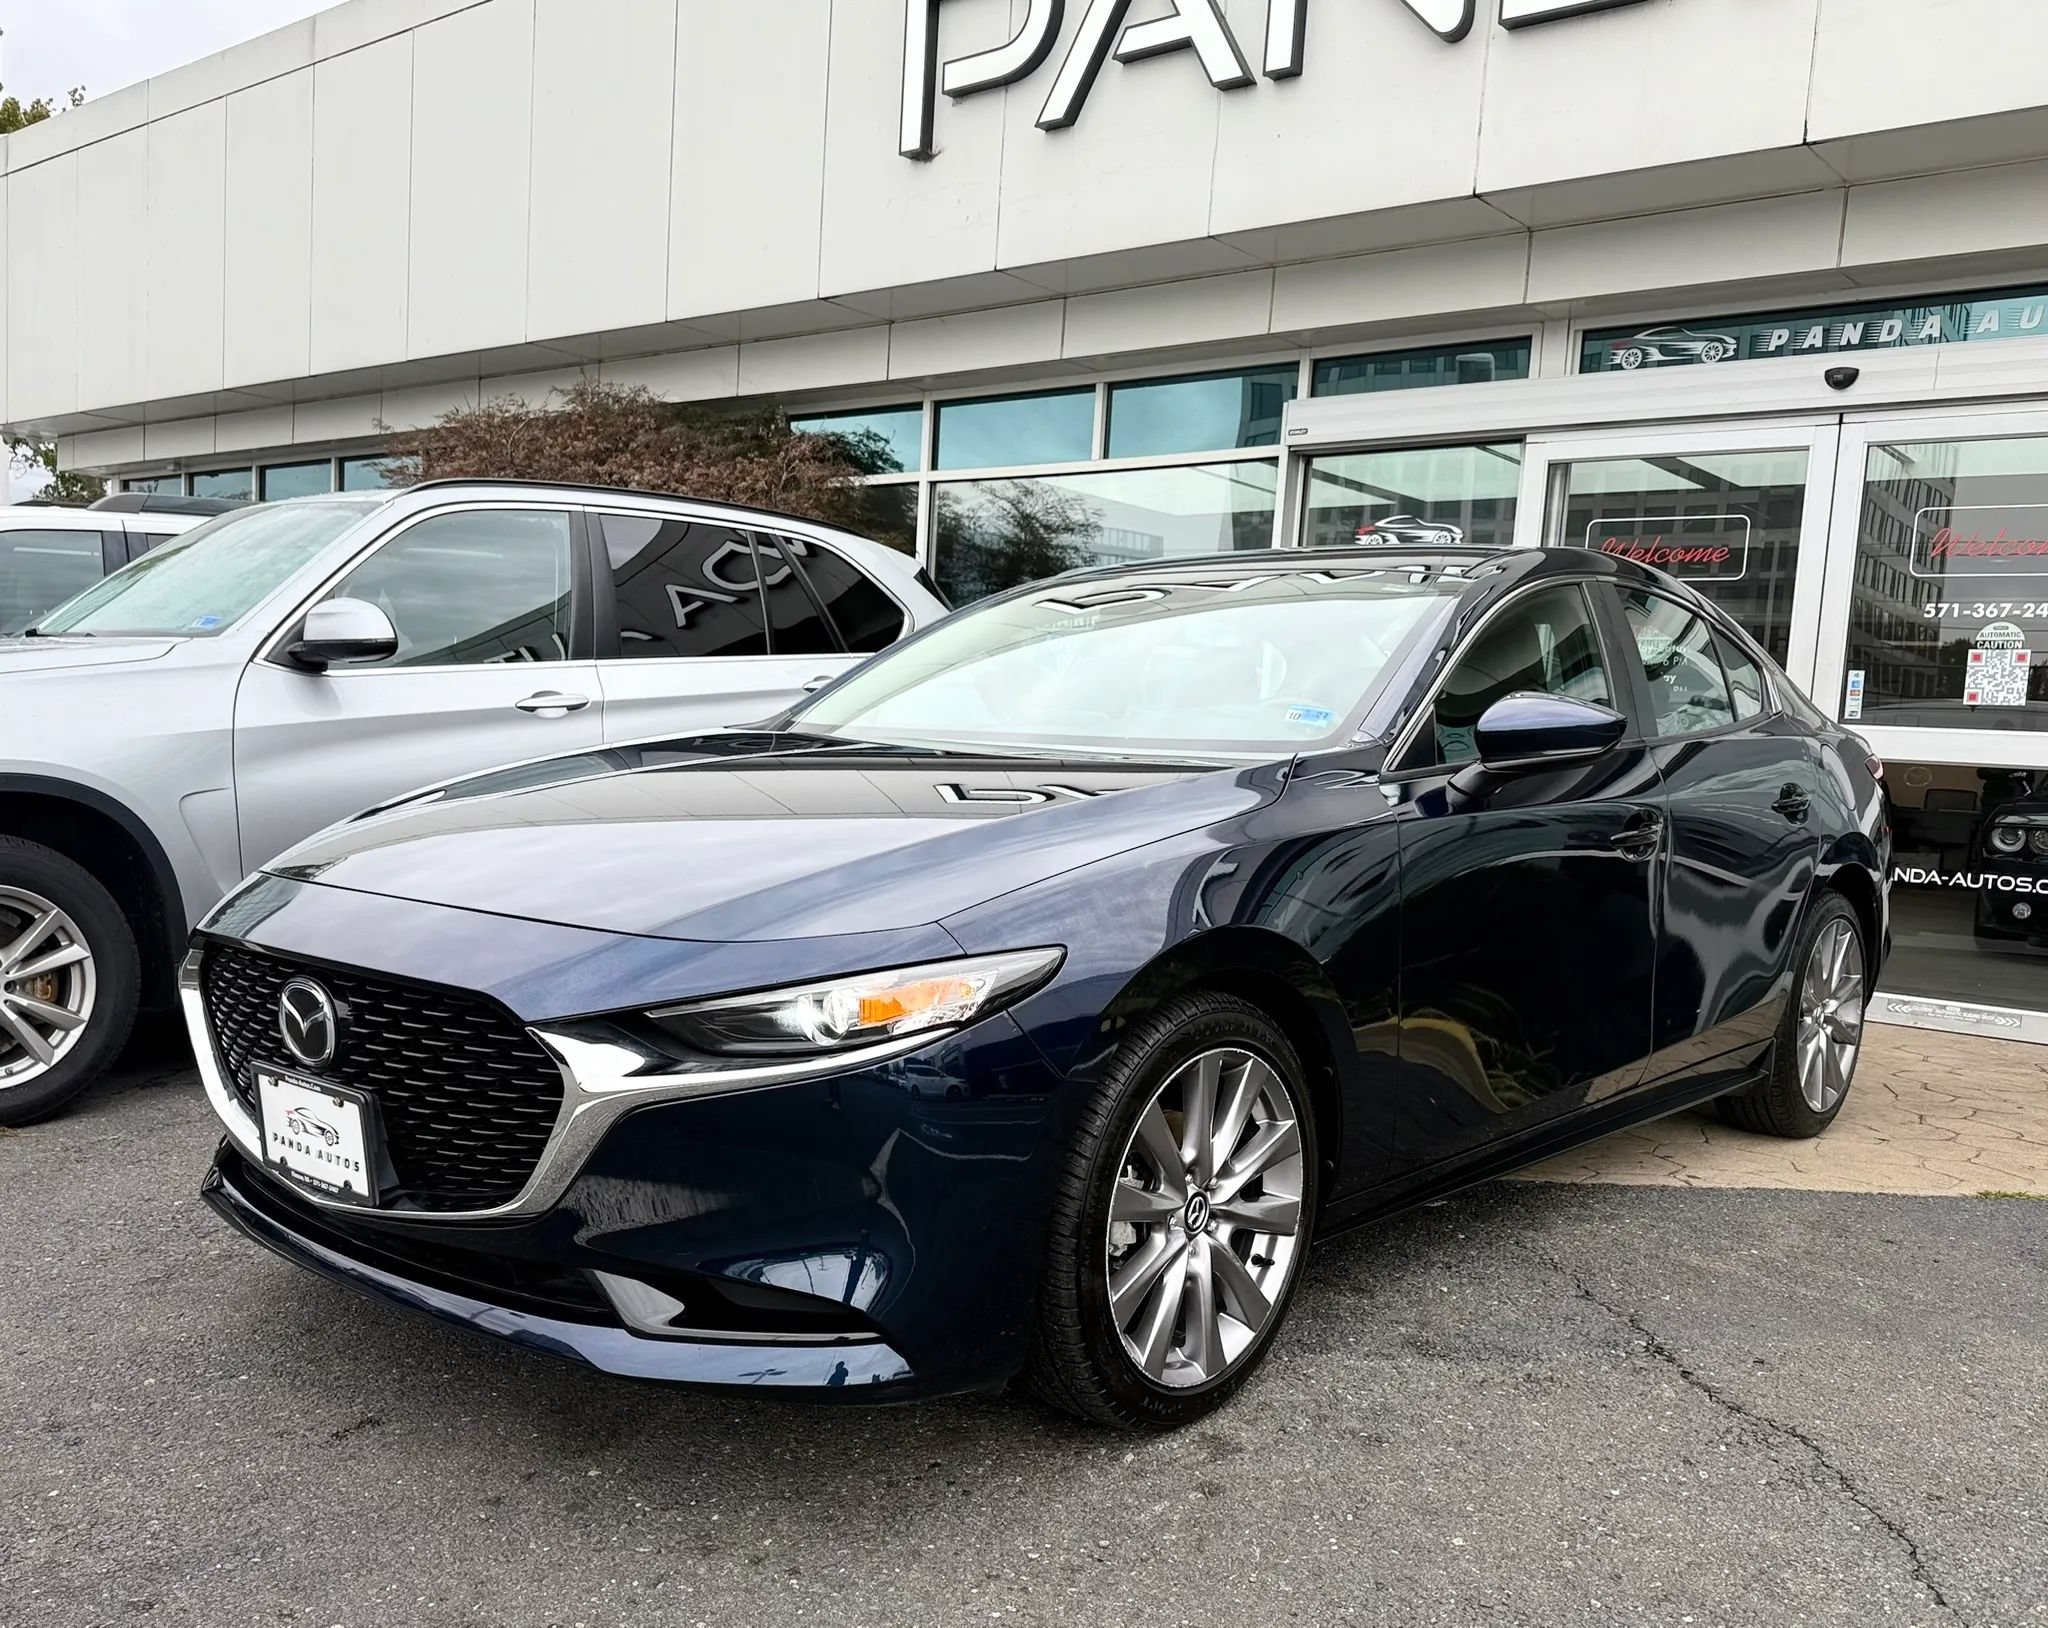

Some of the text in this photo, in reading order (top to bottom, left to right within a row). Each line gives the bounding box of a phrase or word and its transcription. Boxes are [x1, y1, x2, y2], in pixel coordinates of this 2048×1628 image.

[1762, 314, 1942, 351] PANDA
[1600, 535, 1731, 564] Welcome
[1929, 527, 2048, 558] Welco
[1923, 602, 2048, 618] 571-367-24
[1976, 640, 2024, 649] CAUTION
[1979, 631, 2022, 639] AUTOMATIC
[1662, 674, 1677, 685] ay
[1890, 866, 2048, 895] NDA-AUTOS.C
[272, 1131, 361, 1172] PANDA AUTOS
